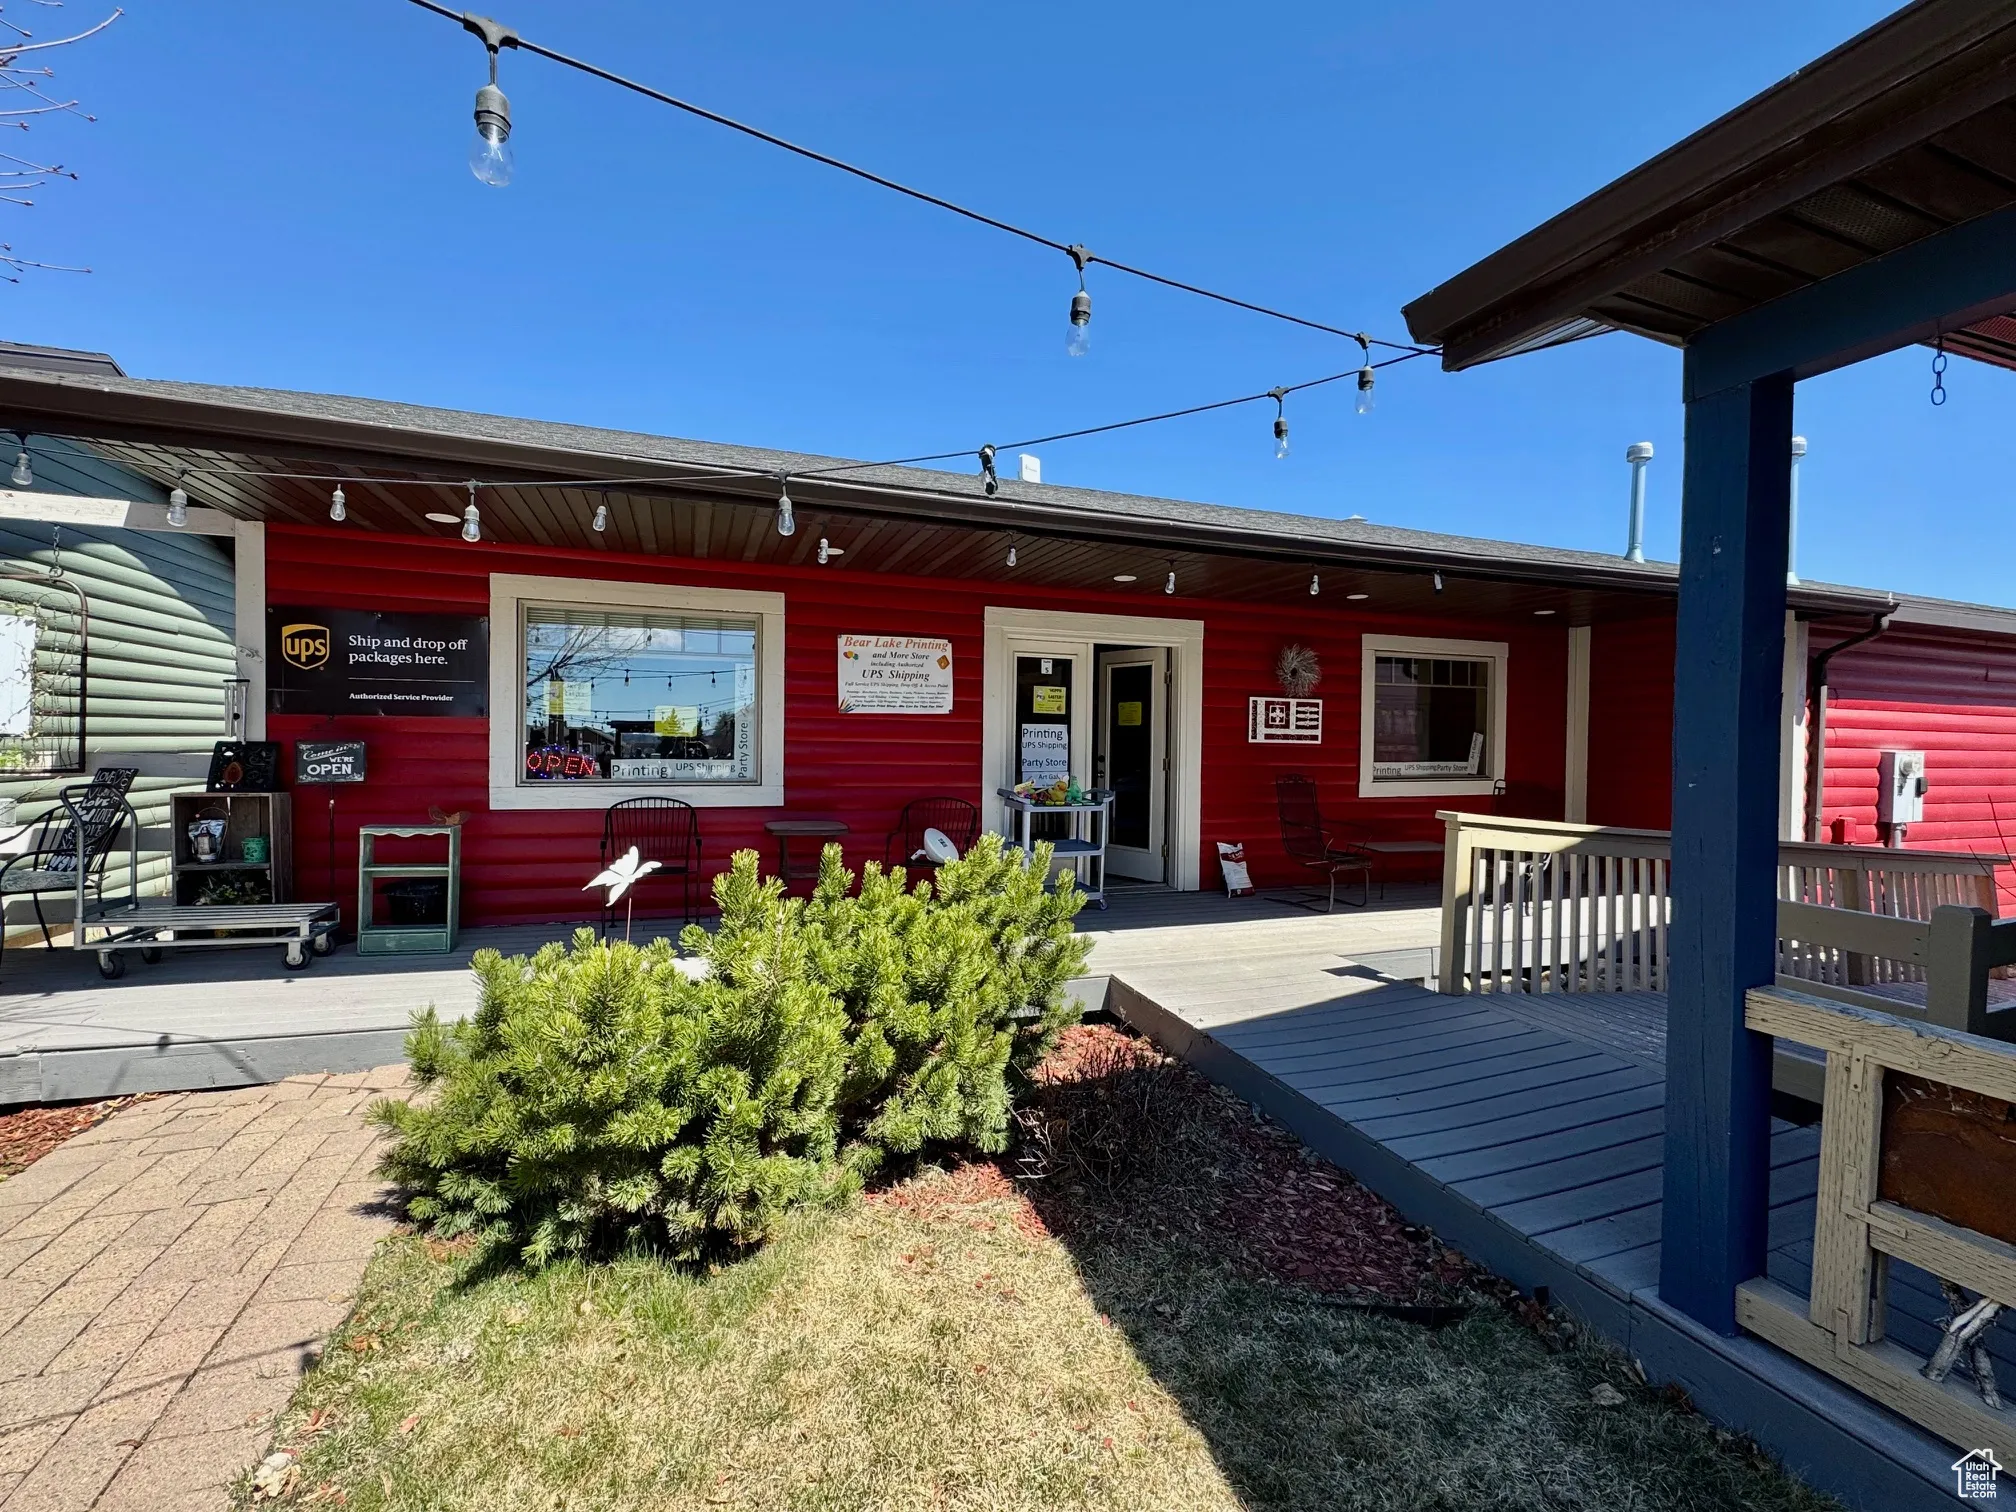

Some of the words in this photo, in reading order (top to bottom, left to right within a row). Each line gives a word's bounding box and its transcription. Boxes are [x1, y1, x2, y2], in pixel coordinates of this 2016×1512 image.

[285, 637, 326, 662] ups
[348, 634, 381, 649] Ship
[383, 637, 411, 648] and
[413, 637, 446, 652] drop
[448, 639, 468, 650] off
[843, 636, 872, 647] Bear
[873, 637, 902, 648] Lake
[904, 638, 949, 652] Printing
[348, 651, 412, 666] packages
[414, 652, 448, 665] here.
[872, 651, 888, 659] and
[888, 651, 910, 659] More
[910, 651, 930, 660] Store
[861, 669, 884, 679] UPS
[888, 669, 930, 682] Shipping
[349, 692, 393, 701] Authorized
[393, 693, 421, 701] Service
[421, 693, 454, 702] Provider
[737, 722, 748, 750] Store
[1022, 728, 1063, 741] Printing
[1021, 741, 1036, 749] UPS
[1037, 741, 1067, 750] Shipping
[303, 749, 334, 761] Come
[306, 763, 352, 775] OPEN
[526, 751, 595, 776] OPEN
[675, 762, 694, 771] UPS
[696, 762, 736, 773] Shipping
[737, 752, 750, 779] Party
[1021, 758, 1044, 768] Party
[1045, 757, 1067, 767] Store
[1415, 764, 1437, 772] Shipping
[1437, 764, 1452, 772] Party
[1452, 764, 1468, 772] Store
[612, 764, 668, 779] Printing
